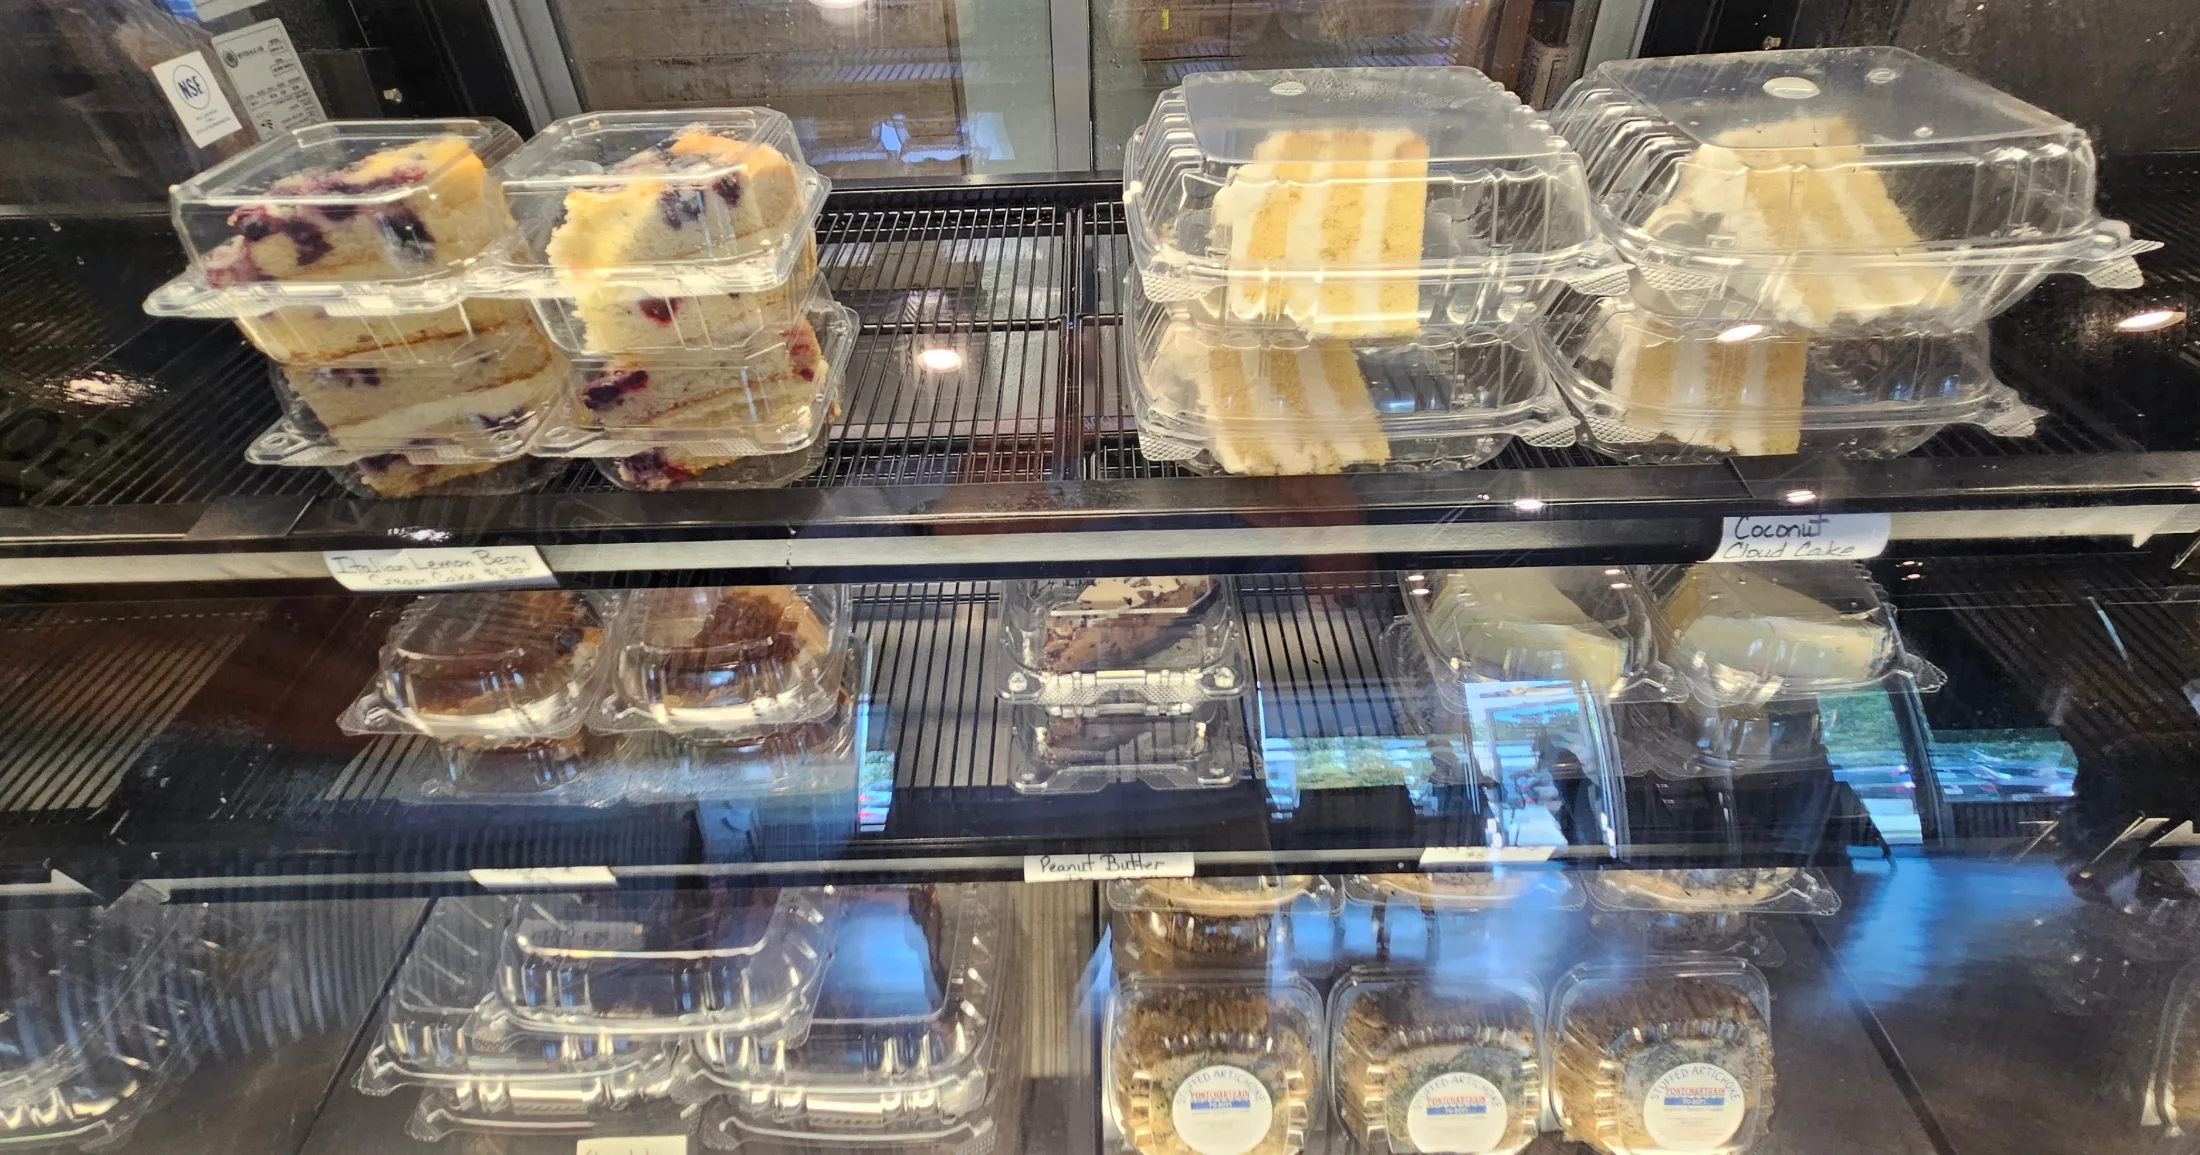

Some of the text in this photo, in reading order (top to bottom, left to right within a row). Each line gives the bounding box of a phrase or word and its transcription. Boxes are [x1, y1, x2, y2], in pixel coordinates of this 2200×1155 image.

[177, 75, 204, 100] NSF
[1735, 513, 1831, 540] Coconut
[1723, 540, 1856, 559] Cloud Cake
[331, 549, 532, 575] Italian Lemon Berry
[368, 574, 430, 586] Cream
[431, 567, 481, 583] Cake
[1040, 852, 1165, 873] Peanut Butter
[1190, 1088, 1250, 1101] PONTCHARTRAIN
[1650, 1067, 1741, 1101] STUFFED ARTICHOKE
[1665, 1087, 1728, 1096] PONTCHARTRAIN
